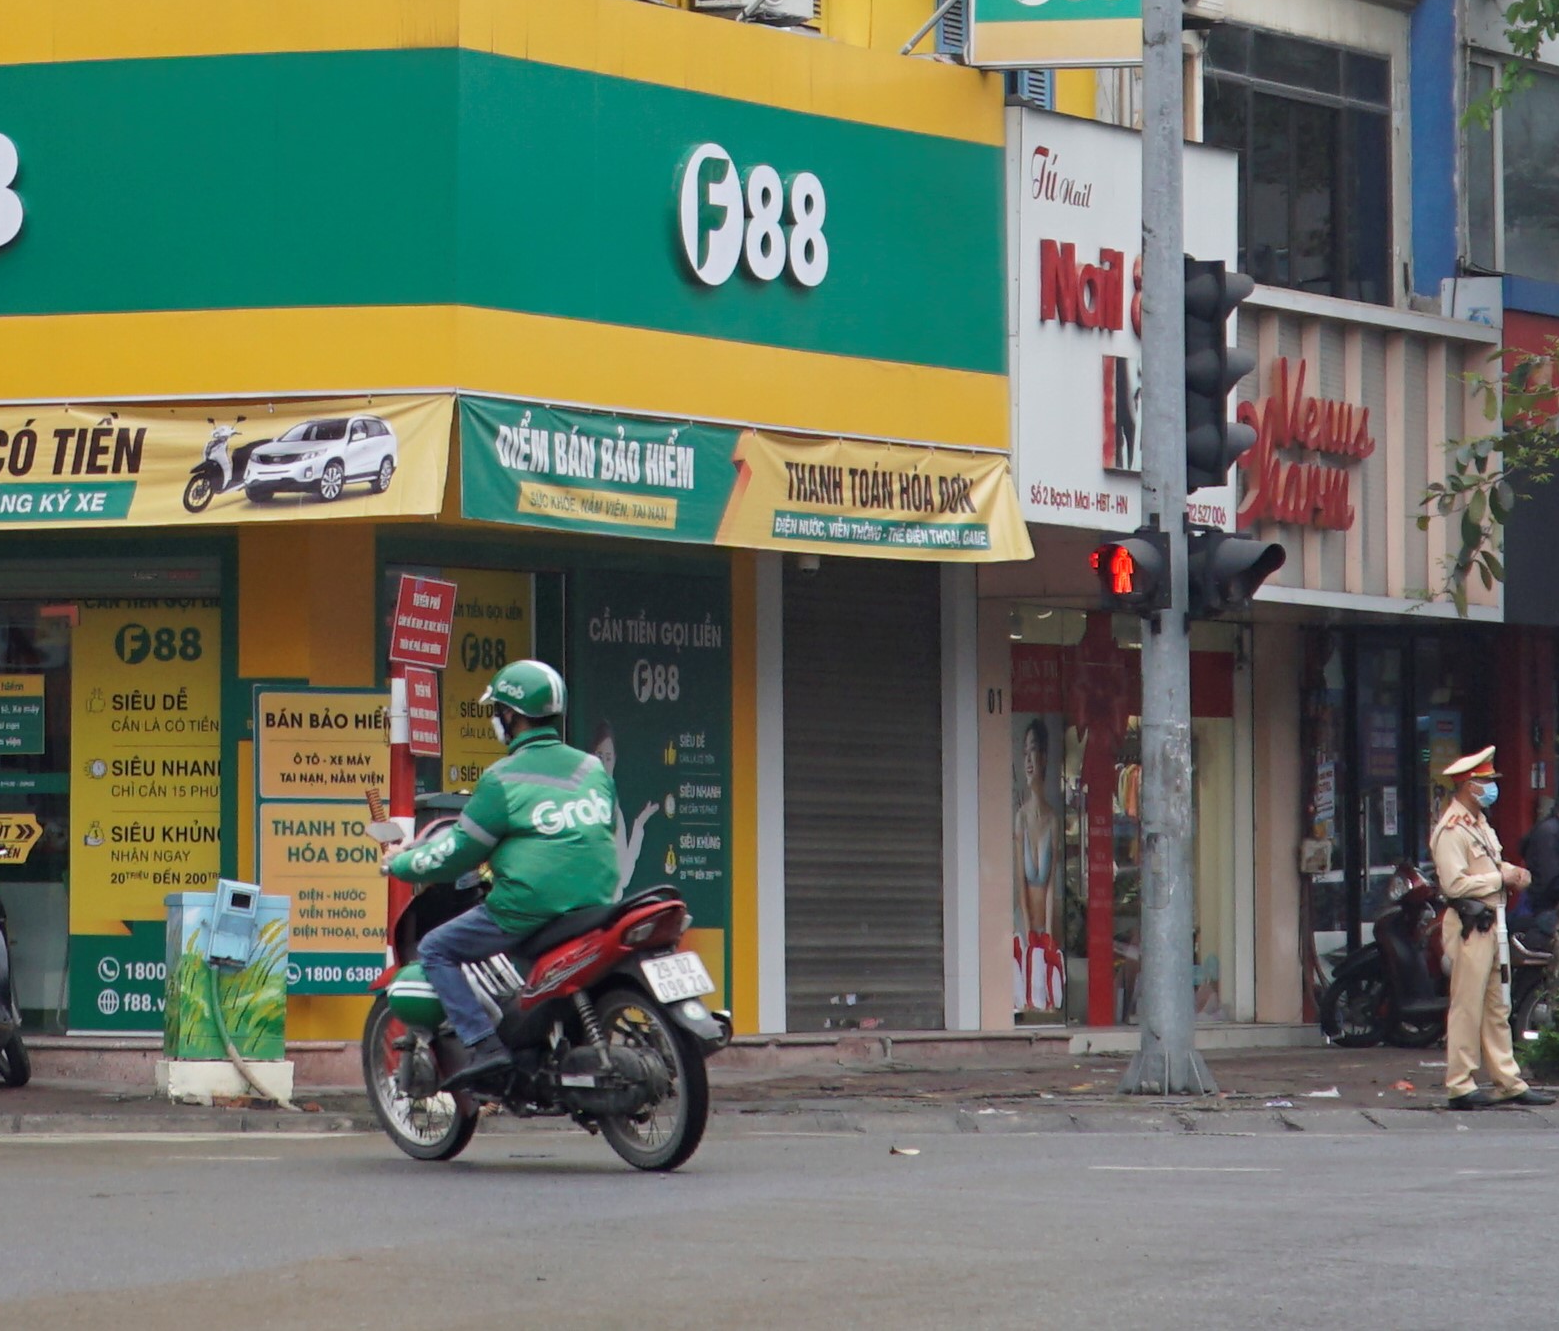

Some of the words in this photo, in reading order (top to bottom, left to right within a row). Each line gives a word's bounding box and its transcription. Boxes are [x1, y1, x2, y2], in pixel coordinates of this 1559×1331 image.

[1032, 145, 1059, 202] Tú
[1060, 178, 1092, 210] Nail
[679, 140, 830, 287] F88
[1040, 238, 1125, 332] Nail
[52, 413, 148, 476] TIỀN
[495, 410, 550, 474] ĐIỂM
[554, 425, 597, 479] BÁN
[600, 425, 641, 484] BẢO
[645, 429, 695, 489] HIỂM
[785, 461, 844, 506] THANH
[848, 462, 895, 510] TOÁN
[899, 466, 935, 514] HÓA
[938, 473, 978, 514] ĐƠN
[1030, 480, 1043, 505] Số
[1043, 487, 1049, 505] 2
[1050, 486, 1072, 511] Bạch
[1074, 488, 1091, 510] Mai
[1115, 494, 1128, 515] HN
[38, 489, 72, 514] KÝ
[74, 492, 108, 513] XE
[775, 514, 798, 535] ĐIỆN
[851, 521, 884, 542] THÔNG
[115, 623, 202, 664] F88
[661, 623, 689, 653] GỌI
[496, 679, 526, 701] Grab
[633, 659, 681, 702] F88
[112, 693, 156, 711] SIÊU
[163, 687, 188, 711] DỄ
[988, 688, 1004, 714] 01
[144, 717, 161, 732] LÀ
[165, 717, 187, 733] CÓ
[266, 709, 309, 729] BÁN
[309, 707, 349, 729] BẢO
[112, 756, 156, 776] SIÊU
[293, 754, 303, 765] Ô
[305, 754, 320, 765] TÔ
[330, 755, 344, 765] XE
[346, 754, 372, 766] MÁY
[280, 772, 297, 784] TAI
[299, 772, 327, 787] NẠN,
[330, 769, 357, 784] NẰM
[360, 771, 385, 785] VIỆN
[173, 786, 187, 798] 15
[531, 787, 613, 836] Grab
[112, 821, 156, 843] SIÊU
[272, 820, 335, 837] THANH
[153, 850, 191, 863] NGAY
[287, 842, 330, 863] HÓA
[336, 843, 378, 863] ĐƠN
[152, 868, 181, 884] ĐẾN
[298, 889, 324, 903] ĐIỆN
[326, 904, 367, 919] THÔNG
[293, 925, 318, 939] ĐIỆN
[124, 962, 166, 981] 1800
[305, 966, 342, 982] 1800
